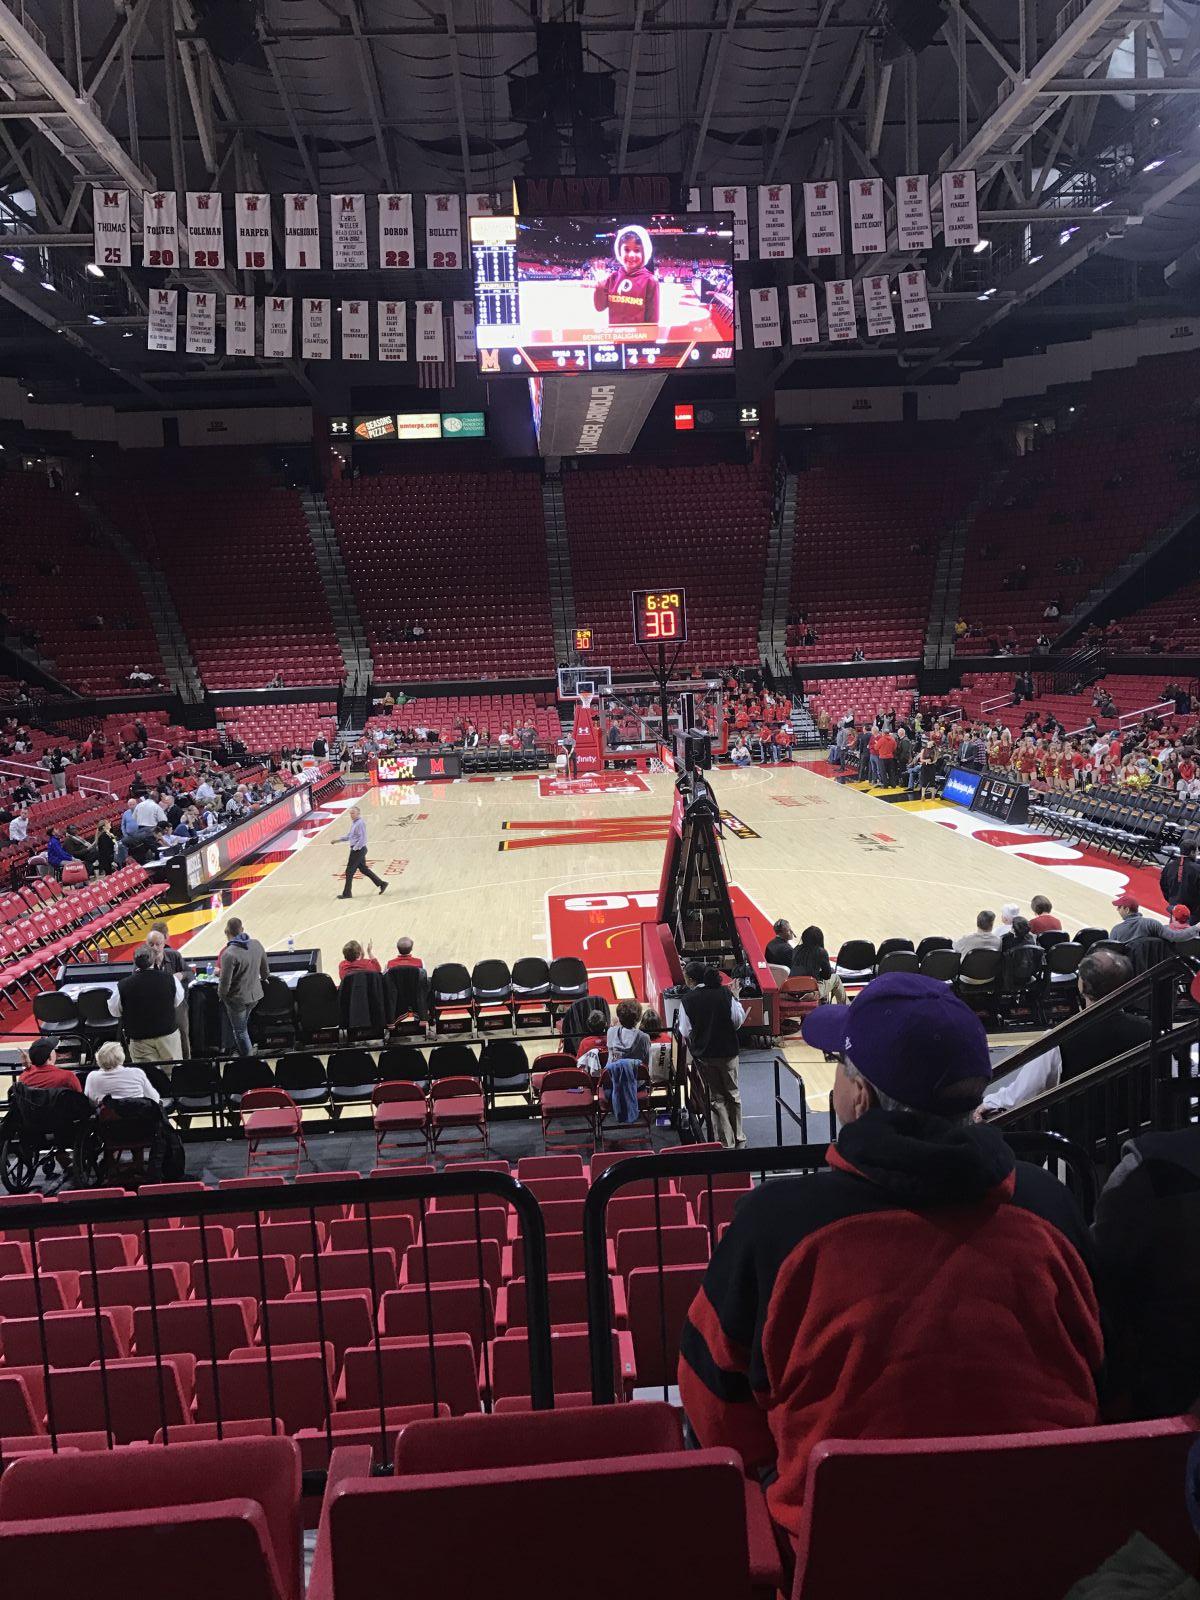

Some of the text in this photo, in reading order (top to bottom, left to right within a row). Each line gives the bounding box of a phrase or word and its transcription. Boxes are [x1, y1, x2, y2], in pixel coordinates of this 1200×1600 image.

[526, 177, 671, 209] MARYLAND
[97, 222, 126, 233] THOMAS
[189, 226, 222, 236] COLEMAN
[239, 228, 269, 237] HARPER
[384, 227, 408, 236] DORON
[429, 228, 458, 237] BULLETT
[104, 247, 121, 263] 25
[149, 249, 174, 266] 20
[194, 250, 219, 267] 25
[245, 251, 265, 268] 15
[299, 251, 306, 267] 1
[385, 250, 409, 267] 22
[433, 251, 457, 268] 23
[608, 294, 643, 306] REDSKINS
[481, 349, 500, 369] M
[712, 347, 733, 359] JSU
[365, 415, 392, 430] SEASONS
[368, 426, 388, 438] PIZZA
[647, 594, 679, 610] 6:29
[645, 611, 675, 637] 30
[576, 638, 589, 649] 30
[430, 757, 444, 772] M
[577, 755, 597, 763] finity
